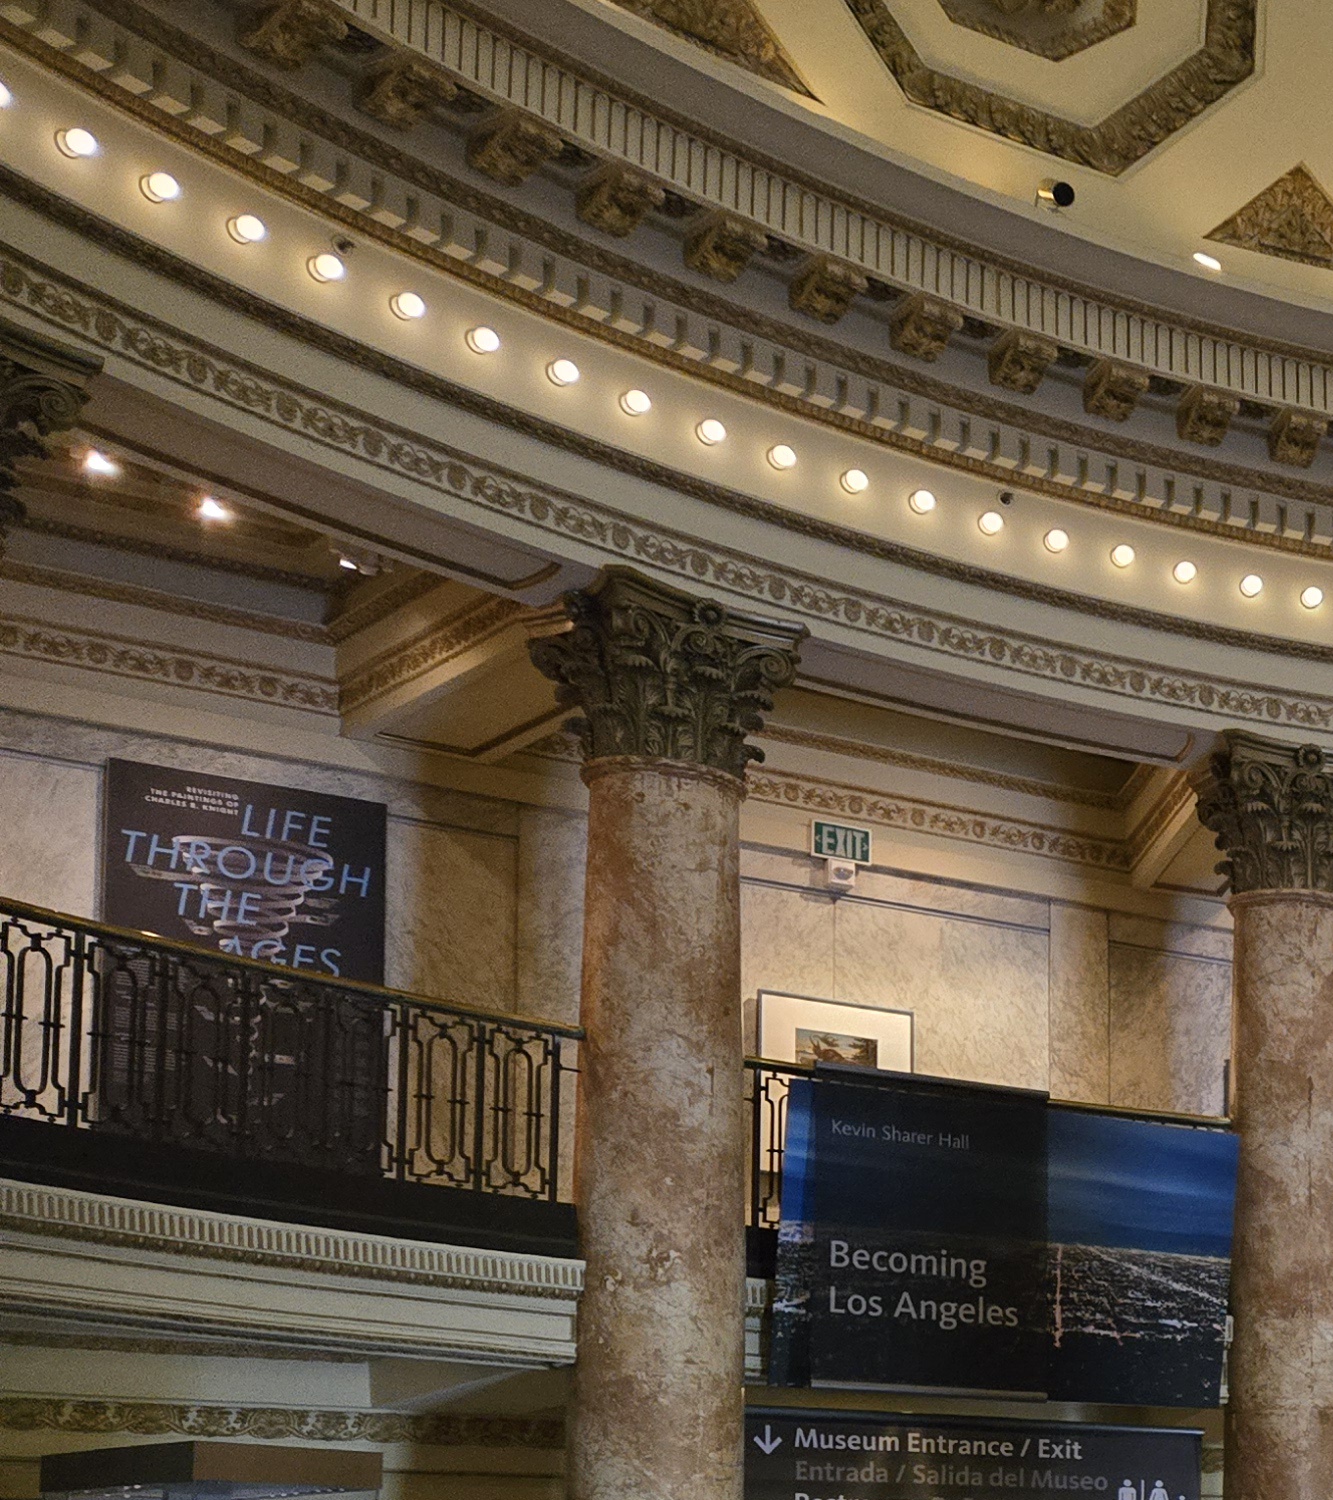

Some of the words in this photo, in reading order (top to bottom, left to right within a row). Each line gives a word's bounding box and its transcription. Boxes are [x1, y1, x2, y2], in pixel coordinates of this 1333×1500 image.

[144, 794, 187, 808] CHARLES
[202, 804, 239, 817] KNIGHT
[150, 787, 169, 797] THE
[171, 791, 223, 805] PAINTINGS
[226, 800, 239, 808] OF
[240, 803, 332, 848] LIFE
[821, 825, 866, 860] EXIT
[121, 828, 371, 898] THROUGH
[173, 882, 262, 926] THE
[831, 1118, 876, 1139] Kevin
[881, 1125, 934, 1146] Sharer
[938, 1132, 970, 1150] Hall
[829, 1239, 987, 1288] Becoming
[829, 1285, 883, 1317] Los
[893, 1290, 1019, 1330] Angeles
[794, 1427, 900, 1452] Museum
[907, 1432, 1014, 1457] Entrance
[1038, 1439, 1083, 1460] Exit
[796, 1460, 889, 1484] Entrada
[912, 1464, 983, 1487] Salida
[989, 1467, 1025, 1487] del
[1031, 1470, 1109, 1491] Museo
